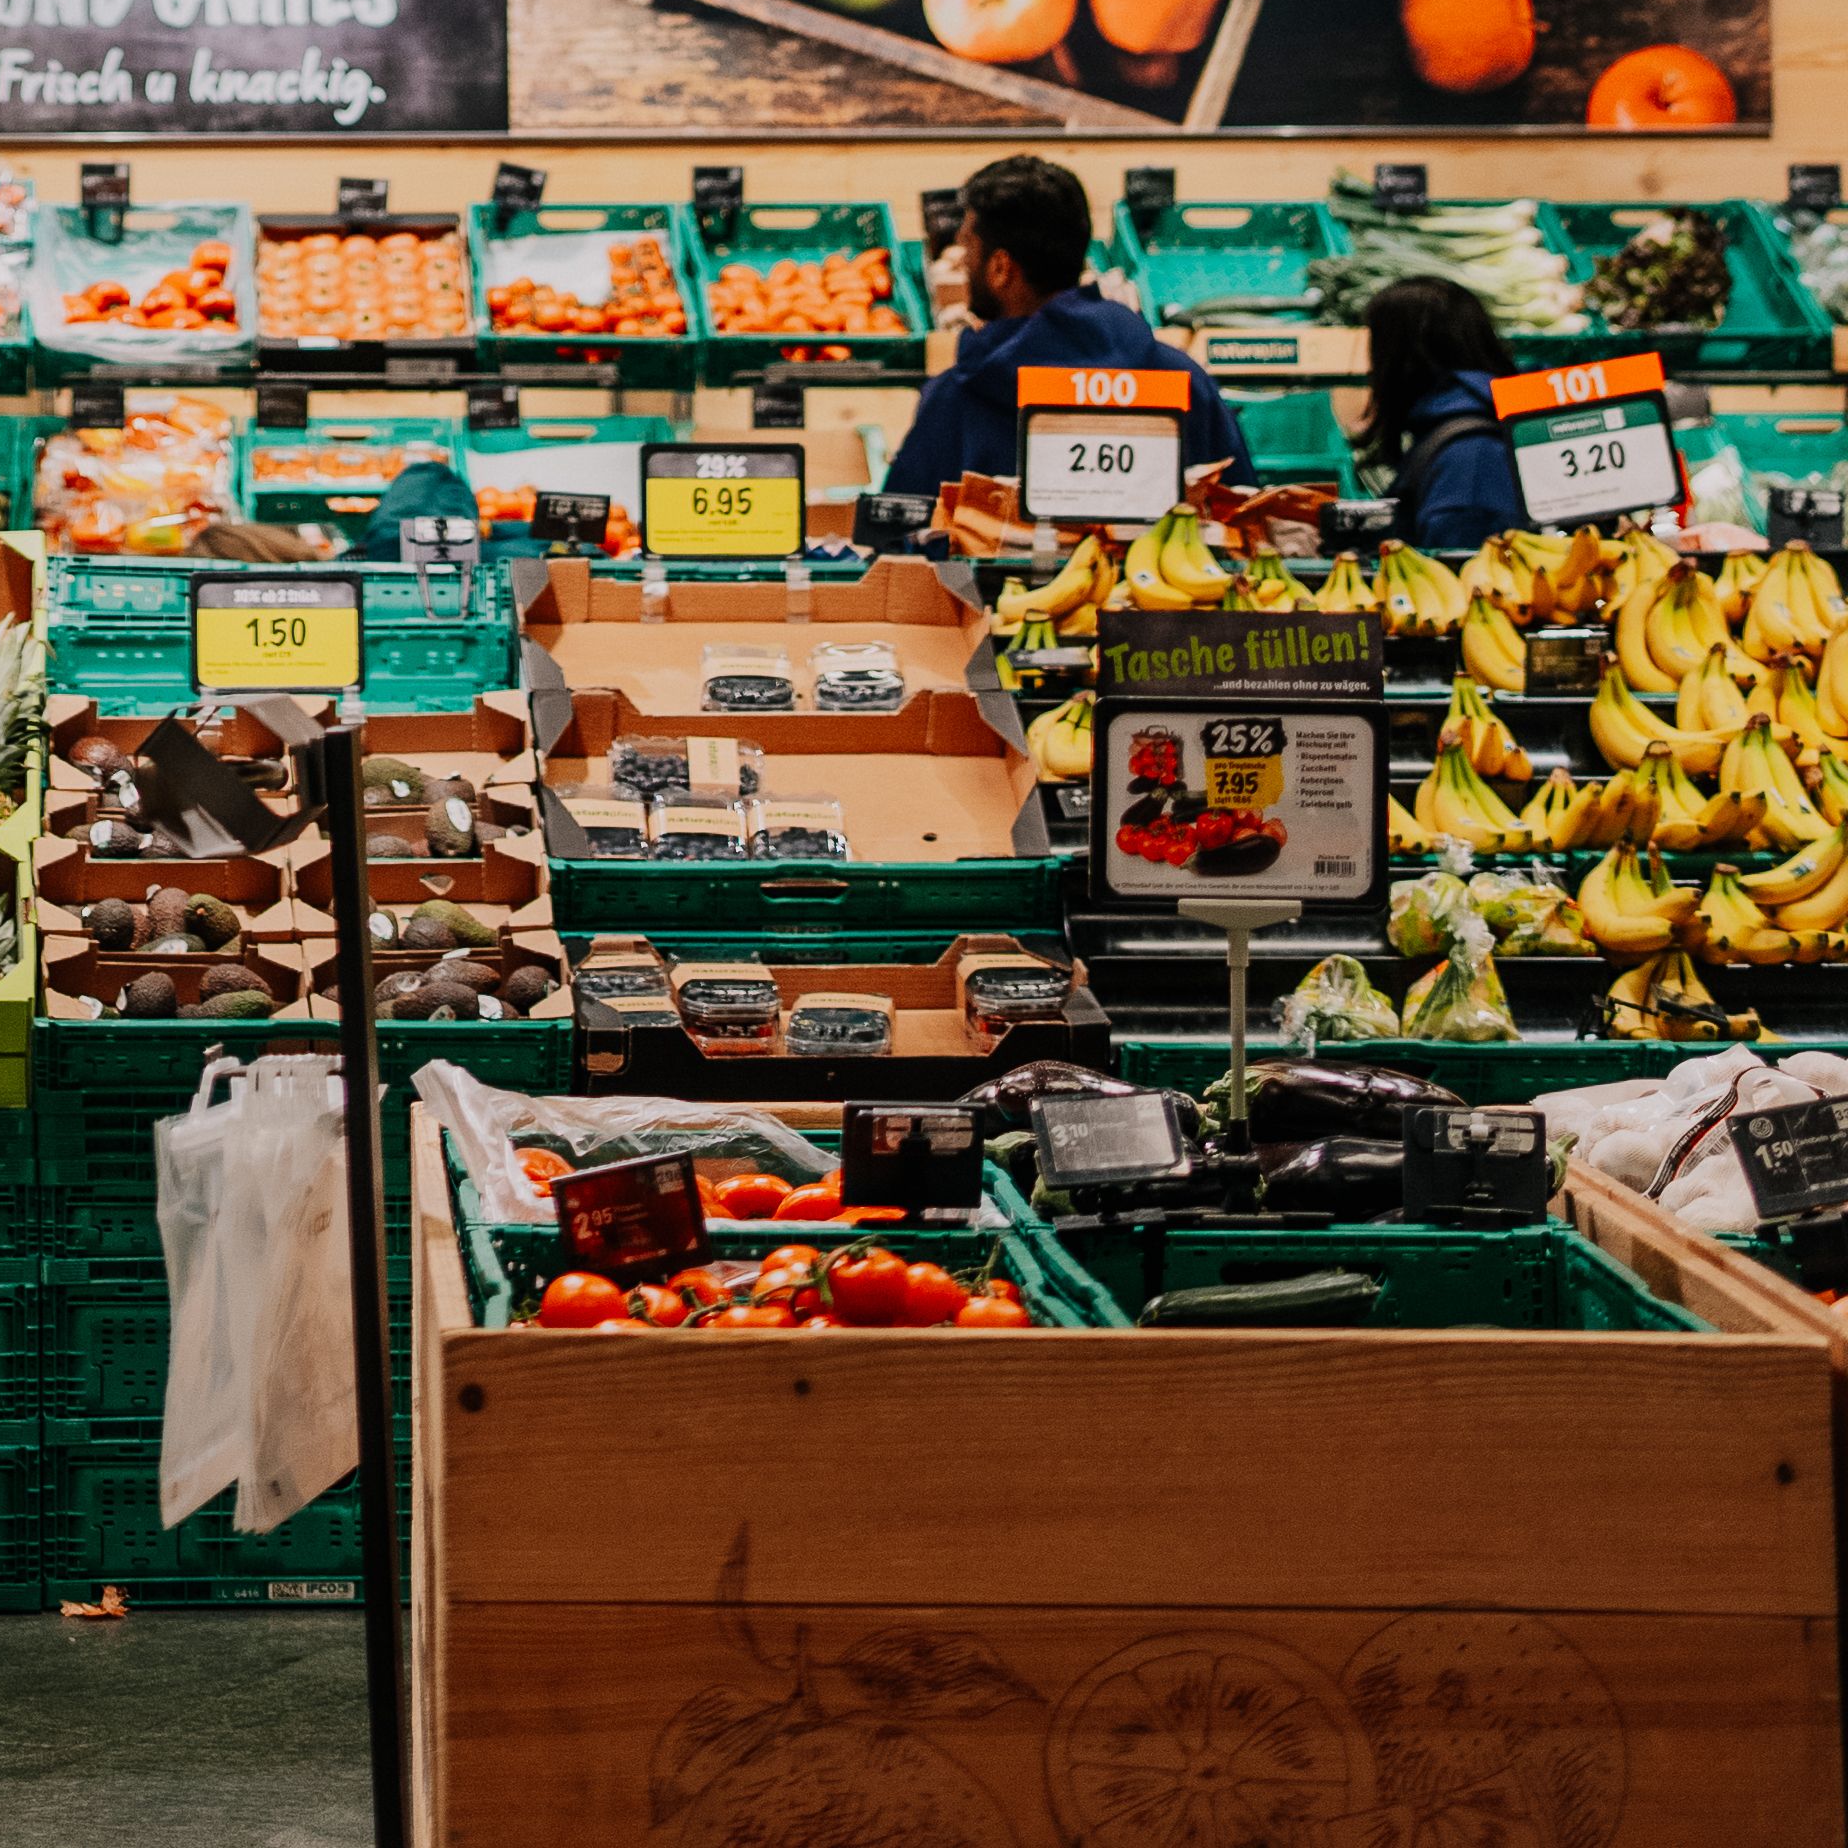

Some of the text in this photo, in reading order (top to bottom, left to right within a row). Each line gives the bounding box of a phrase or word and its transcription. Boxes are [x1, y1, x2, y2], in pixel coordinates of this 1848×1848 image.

[146, 71, 177, 104] u
[189, 46, 387, 126] knackig.
[1070, 371, 1138, 406] 100
[1547, 365, 1608, 405] 101
[696, 454, 748, 478] 29%
[1069, 443, 1134, 473] 2.60
[1560, 441, 1625, 477] 3.20
[693, 487, 752, 515] 6.95
[246, 617, 306, 647] 1.50
[1103, 620, 1370, 683] Tasche füllen!
[1244, 679, 1291, 691] bezahlen
[1292, 680, 1318, 691] ohne
[1319, 681, 1333, 691] zu
[1333, 680, 1370, 693] wägen.
[1211, 724, 1273, 753] 25%
[1295, 731, 1325, 739] Machen
[1214, 771, 1260, 795] 7.95
[1335, 800, 1353, 809] gelb
[1051, 1122, 1089, 1148] 3.10
[1754, 1139, 1794, 1170] 1.50
[572, 1207, 613, 1240] 2.95
[306, 1583, 337, 1594] IFCO
